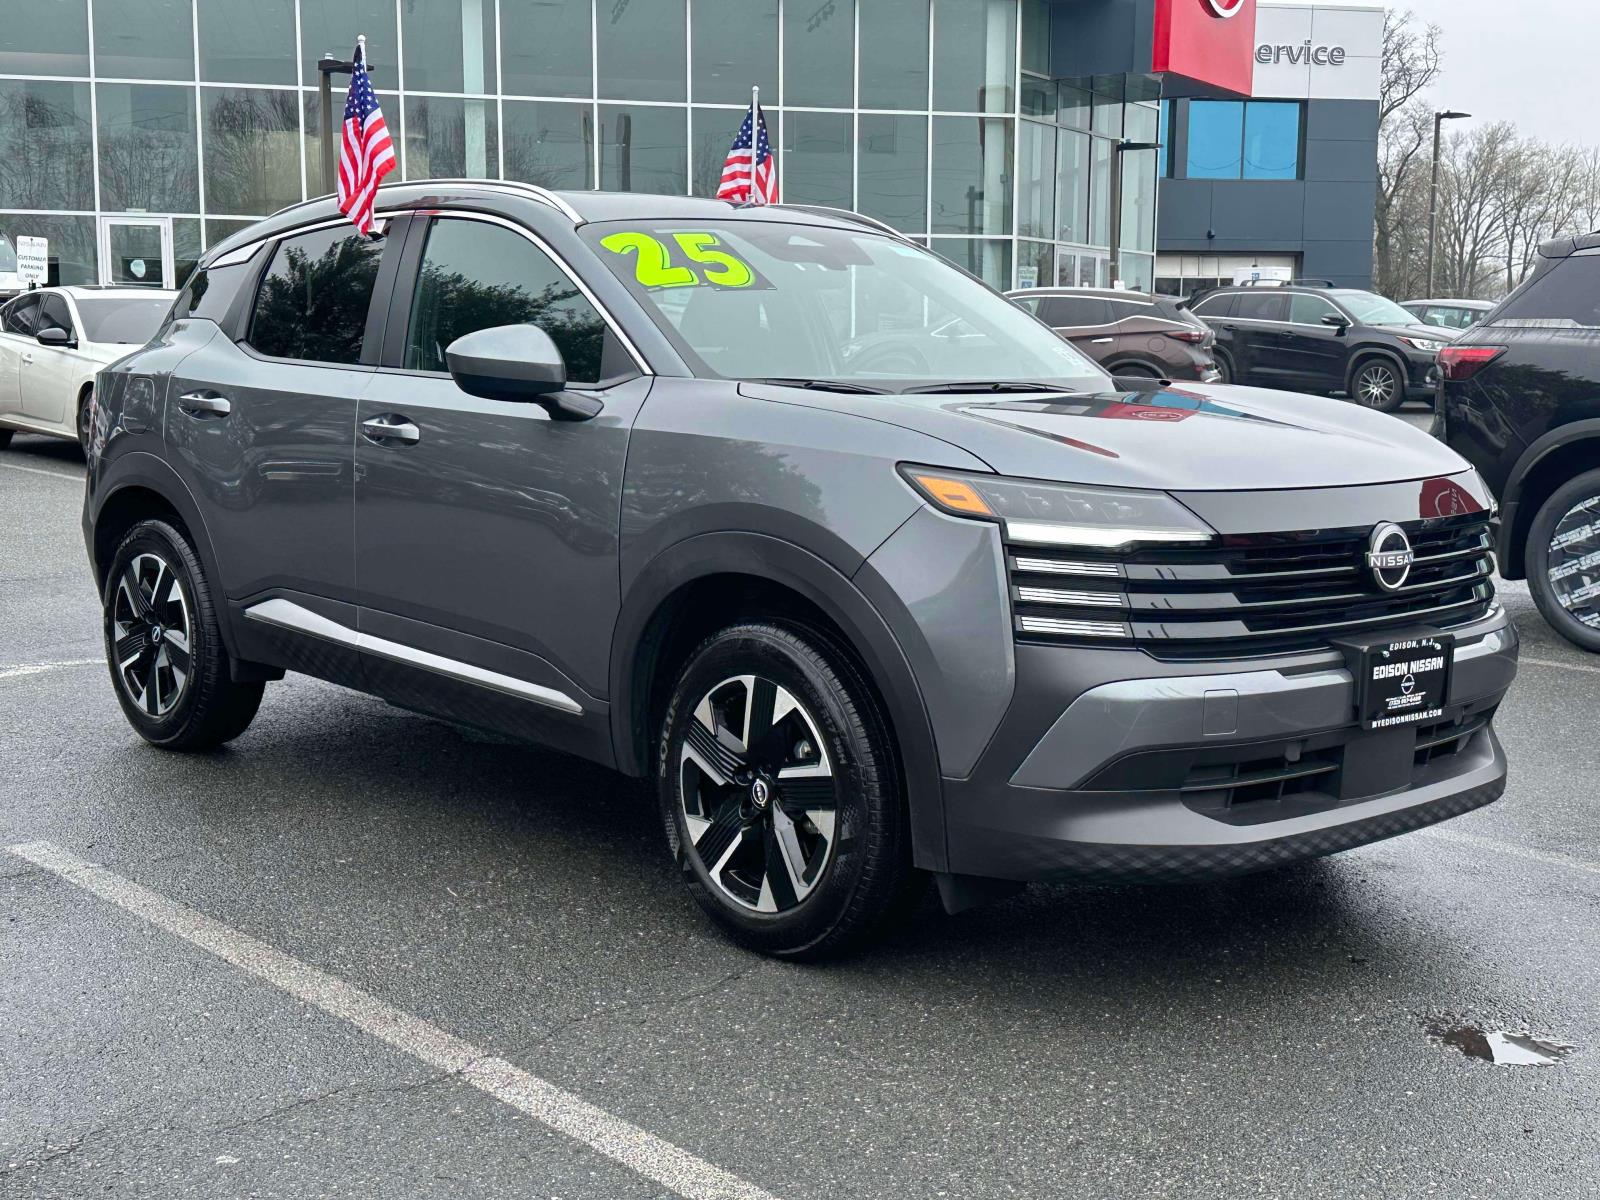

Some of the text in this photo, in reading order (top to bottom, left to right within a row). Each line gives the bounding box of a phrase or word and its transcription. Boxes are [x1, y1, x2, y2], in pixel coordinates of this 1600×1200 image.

[1255, 40, 1345, 65] ervice
[600, 231, 756, 287] 25
[1370, 553, 1414, 566] NISSAN
[1389, 641, 1419, 651] EDISON,
[1372, 656, 1444, 680] EDISON NISSAN
[1371, 708, 1442, 728] MYEDISONNISSAN.COM
[659, 692, 680, 778] SOLUS
